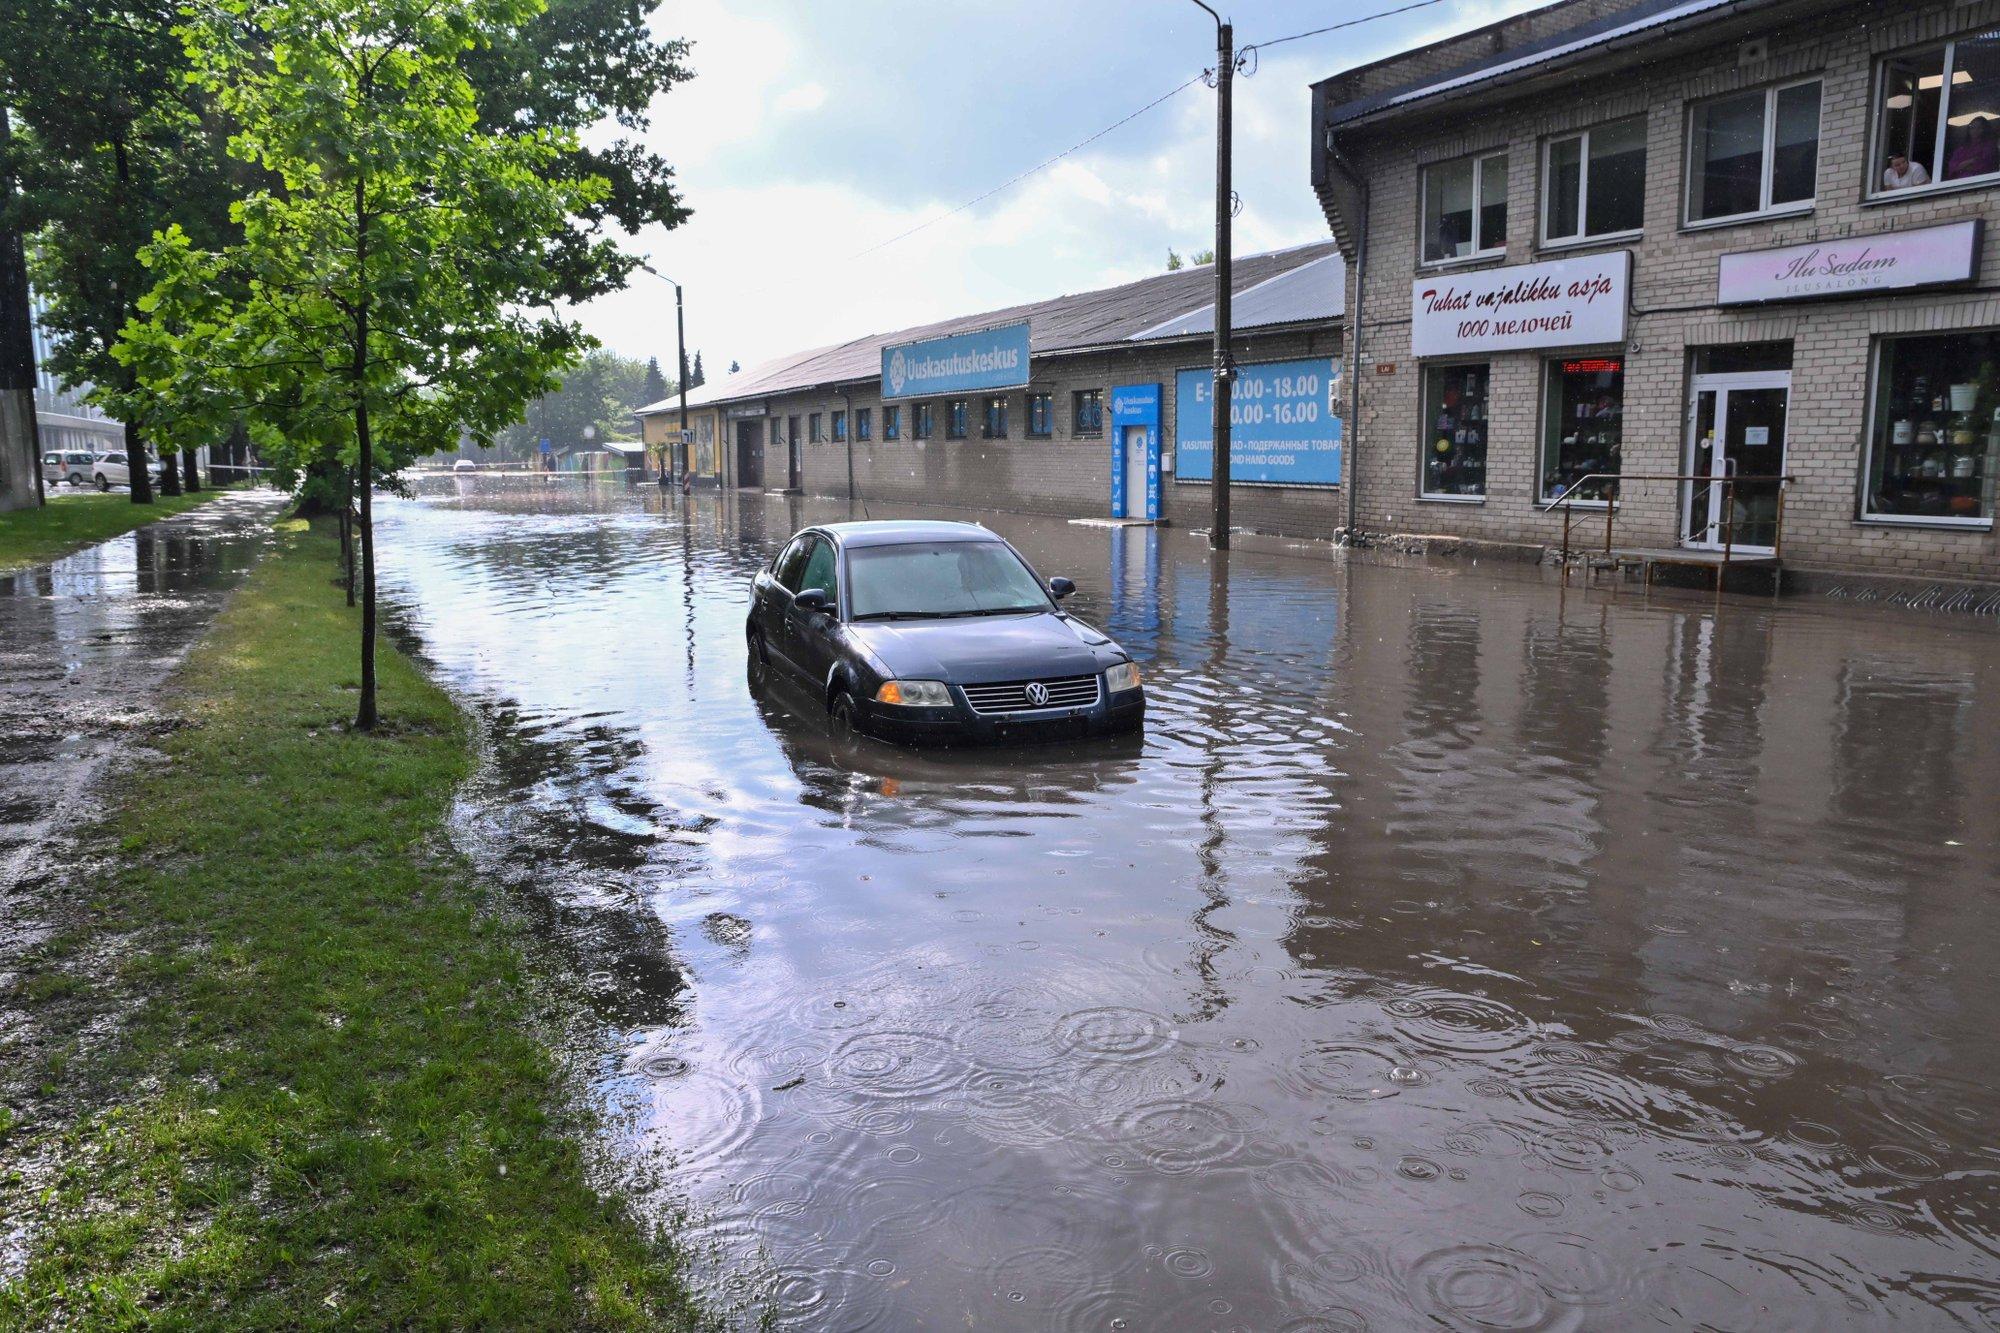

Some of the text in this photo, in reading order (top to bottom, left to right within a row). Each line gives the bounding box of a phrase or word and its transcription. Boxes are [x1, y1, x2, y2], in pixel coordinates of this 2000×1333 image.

[1775, 248, 1898, 281] Ilu Sadam
[1422, 273, 1613, 314] Tuhat vajalikku asja
[1786, 275, 1882, 293] ILUSALONG
[1457, 311, 1572, 338] 1000 мелочей
[908, 346, 1018, 380] Uuskasutuskeskus
[1248, 440, 1309, 452] ПОДЕРЖАННЫЕ
[1245, 455, 1267, 465] HAND
[1267, 455, 1296, 466] GOODS
